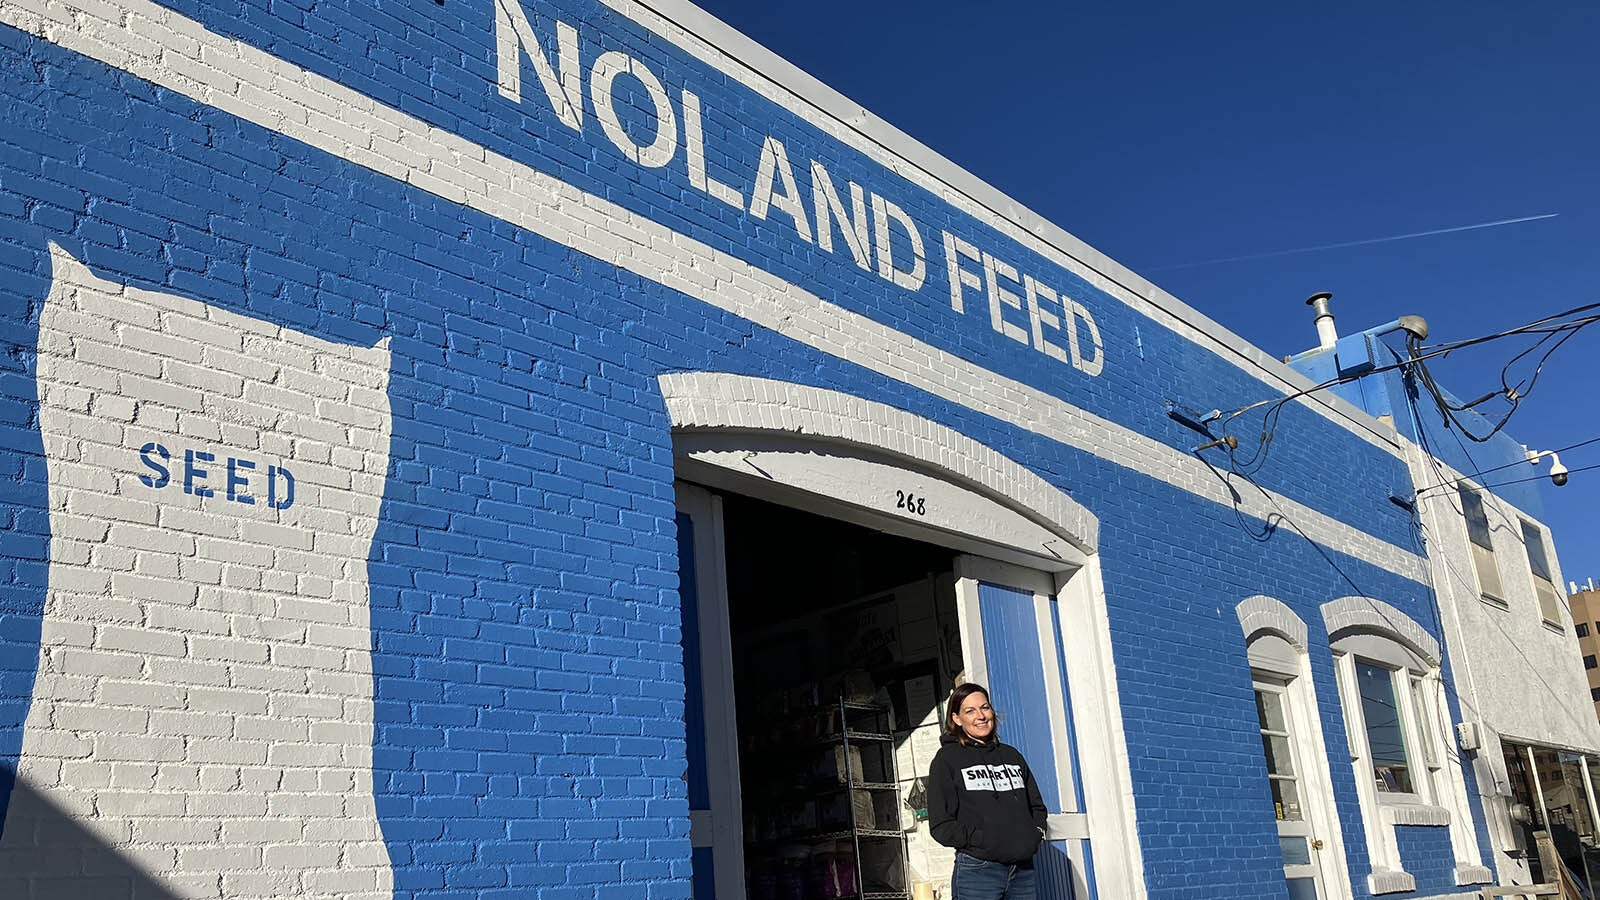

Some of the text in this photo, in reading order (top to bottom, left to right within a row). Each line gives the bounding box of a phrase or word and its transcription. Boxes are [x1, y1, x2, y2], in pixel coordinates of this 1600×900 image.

[495, 0, 1104, 377] NOLAND FEED
[138, 442, 295, 510] SEED
[896, 489, 926, 516] 268
